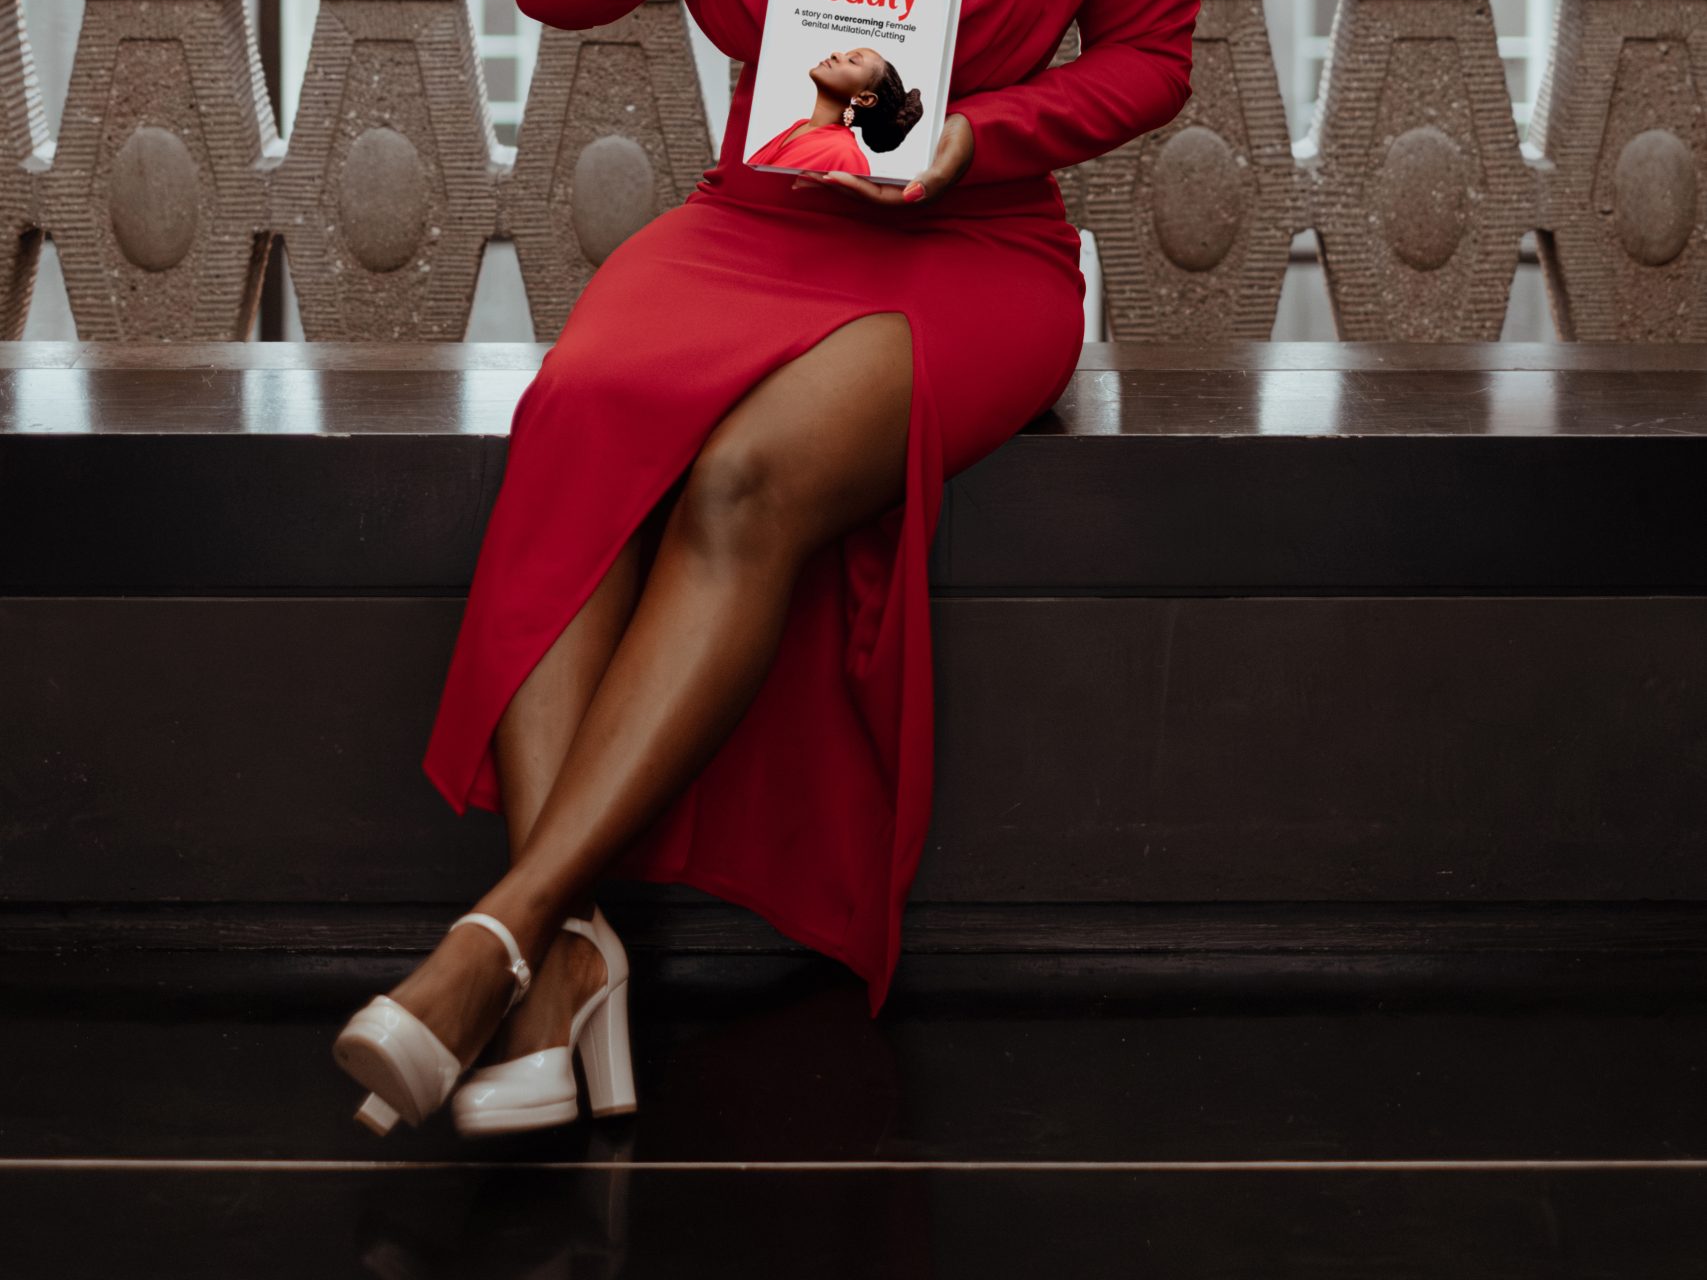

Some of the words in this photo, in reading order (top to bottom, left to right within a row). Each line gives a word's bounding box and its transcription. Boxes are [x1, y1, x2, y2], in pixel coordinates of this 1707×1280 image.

[794, 7, 800, 15] A
[801, 8, 821, 20] story
[822, 12, 833, 20] on
[834, 14, 884, 29] overcoming
[885, 21, 917, 32] Female
[801, 19, 830, 30] Genital
[831, 23, 906, 43] Mutilation/Cutting
